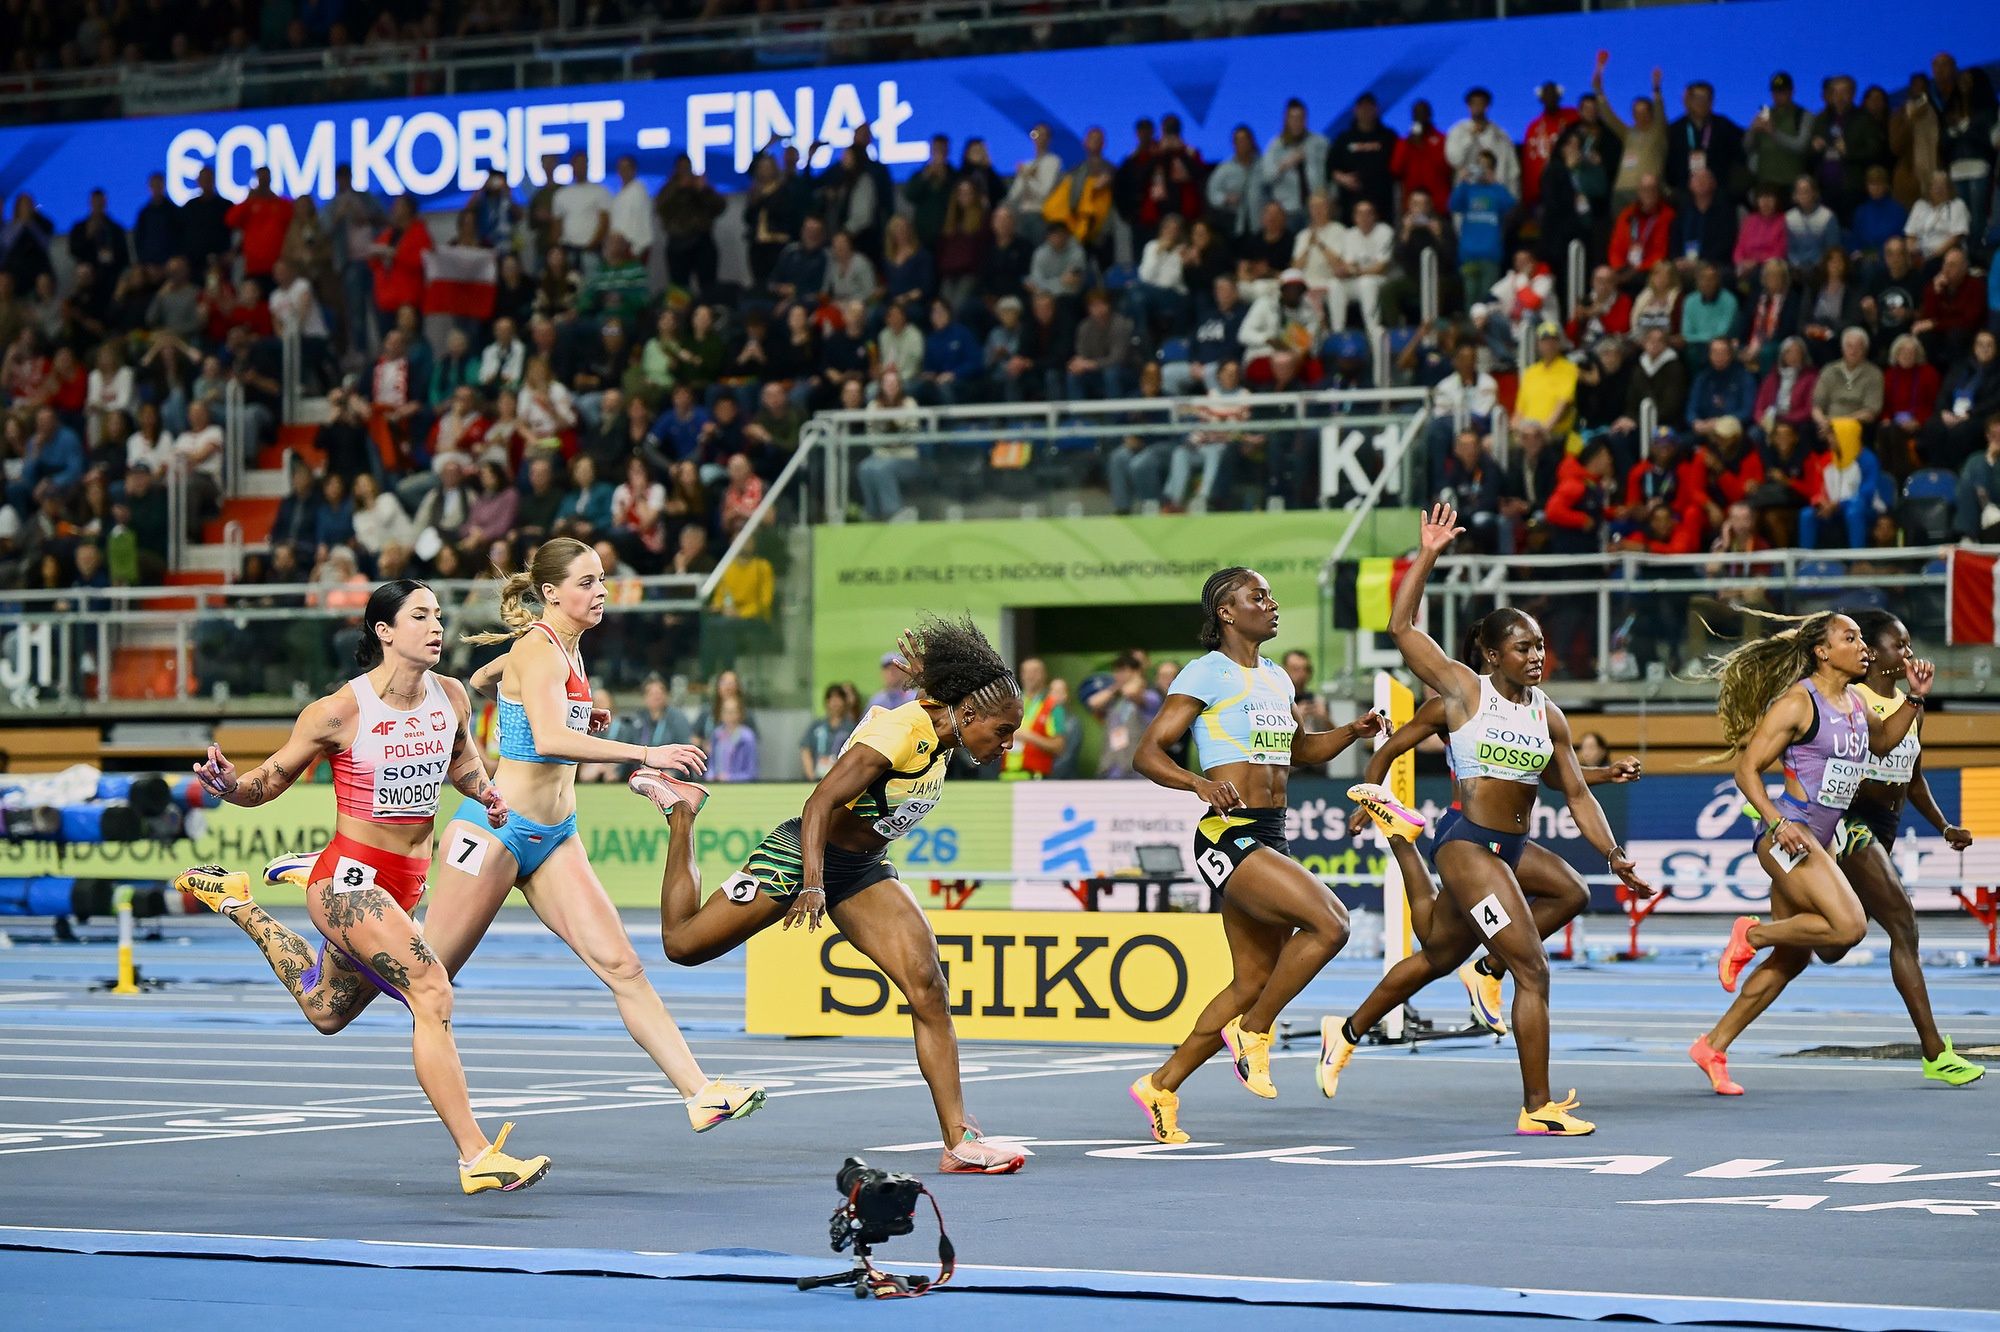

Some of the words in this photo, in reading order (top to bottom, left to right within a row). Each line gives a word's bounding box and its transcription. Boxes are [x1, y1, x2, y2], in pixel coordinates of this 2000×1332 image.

[350, 99, 626, 199] KOBIET
[686, 79, 931, 176] FINAŁ
[1320, 424, 1400, 497] K1
[404, 730, 425, 739] ORLEN
[1485, 728, 1546, 749] SONY
[1833, 730, 1869, 758] USA
[384, 739, 445, 760] POLSKA
[1480, 743, 1545, 769] DOSSO
[383, 760, 447, 781] SONY
[456, 838, 479, 864] 7
[1207, 852, 1225, 877] 5
[187, 876, 226, 894] NITRO
[343, 866, 364, 887] 8
[732, 879, 755, 900] 6
[1484, 904, 1499, 926] 4
[820, 933, 1189, 1022] SEIKO
[863, 1136, 2000, 1184] KUJAW
